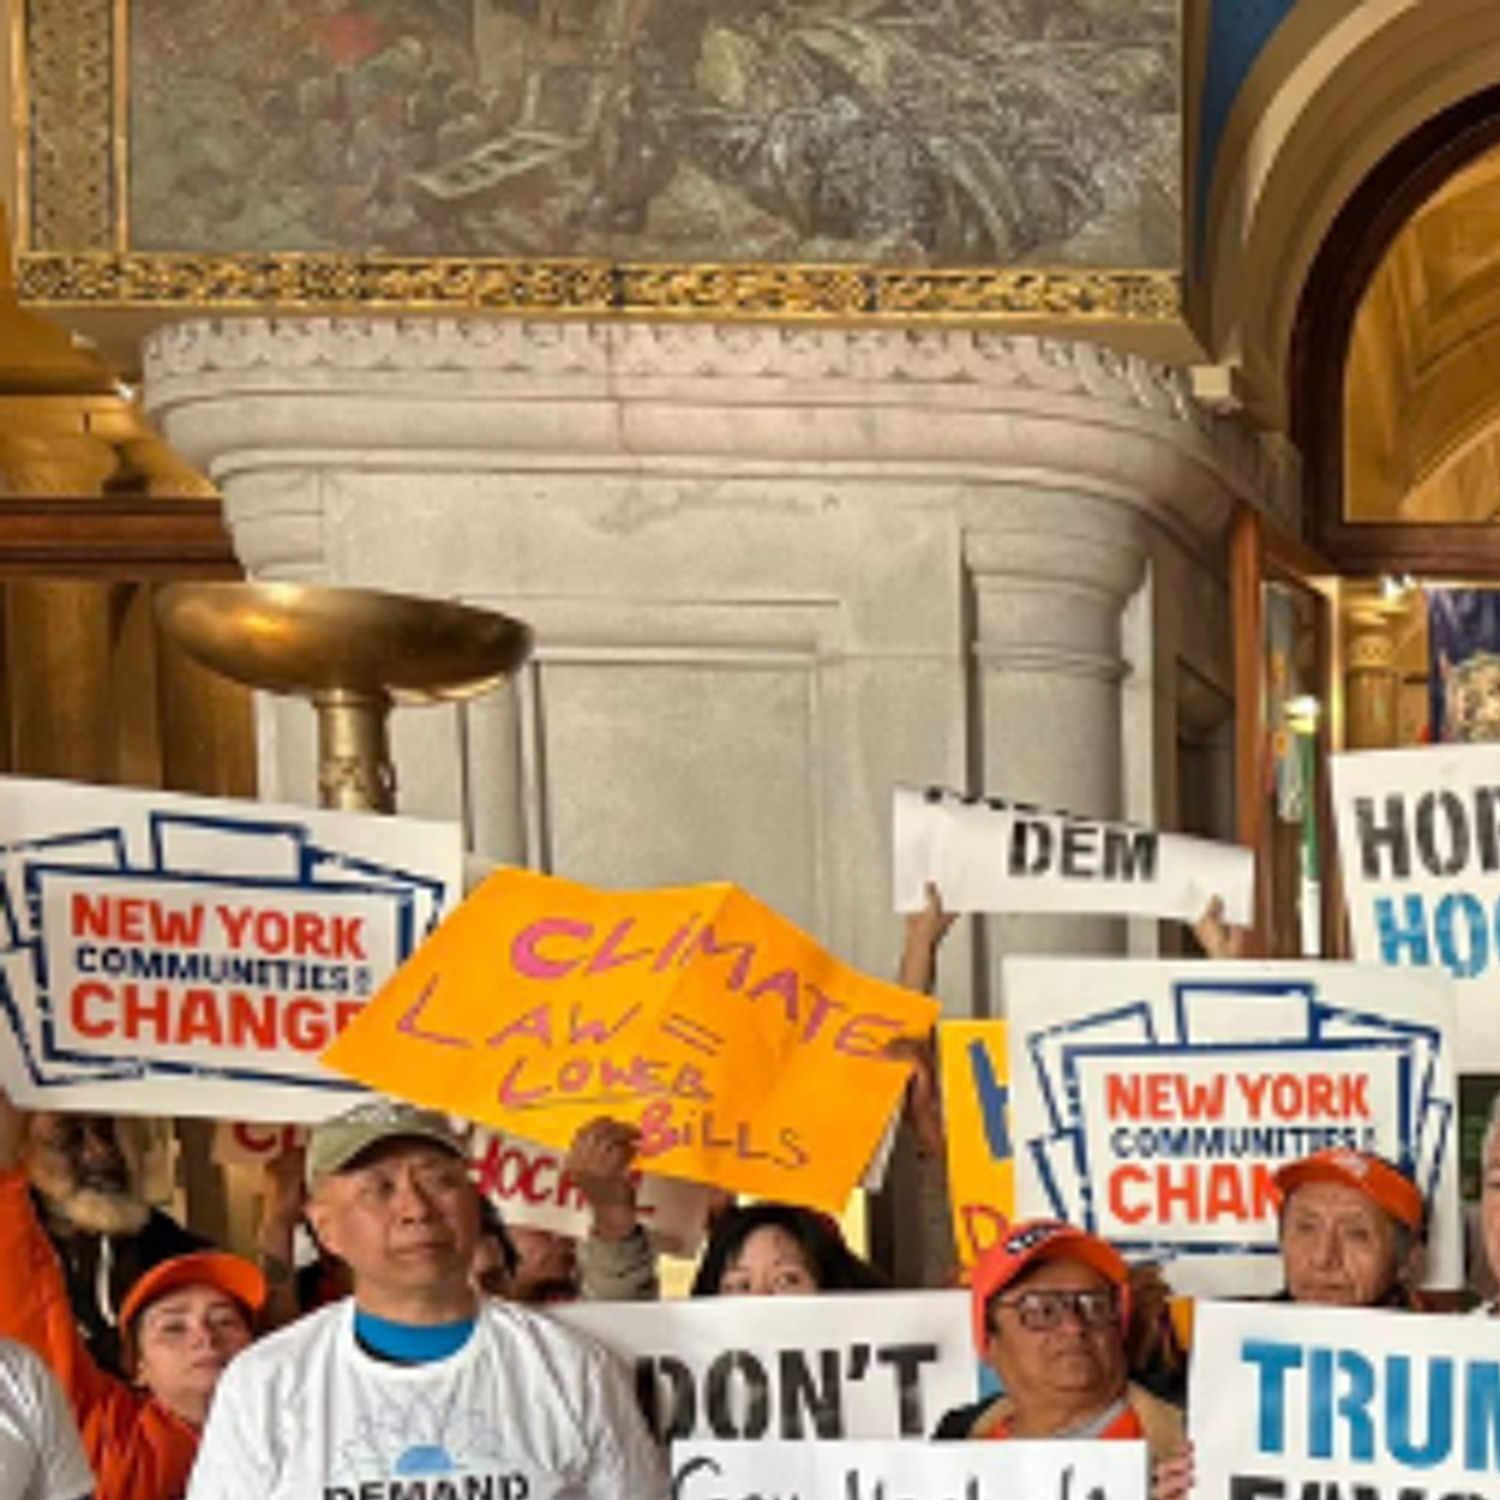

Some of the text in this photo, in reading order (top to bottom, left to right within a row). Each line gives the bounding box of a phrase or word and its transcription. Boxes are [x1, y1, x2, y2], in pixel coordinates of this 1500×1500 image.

[1008, 820, 1160, 881] DEM
[70, 892, 367, 960] NEW YORK
[76, 946, 348, 993] COMMUNITIES
[511, 914, 910, 1062] CLIMATE
[397, 972, 643, 1048] LAW
[1106, 1074, 1371, 1121] NEW YORK
[1108, 1163, 1283, 1225] CHAN
[635, 1343, 939, 1440] DON'T
